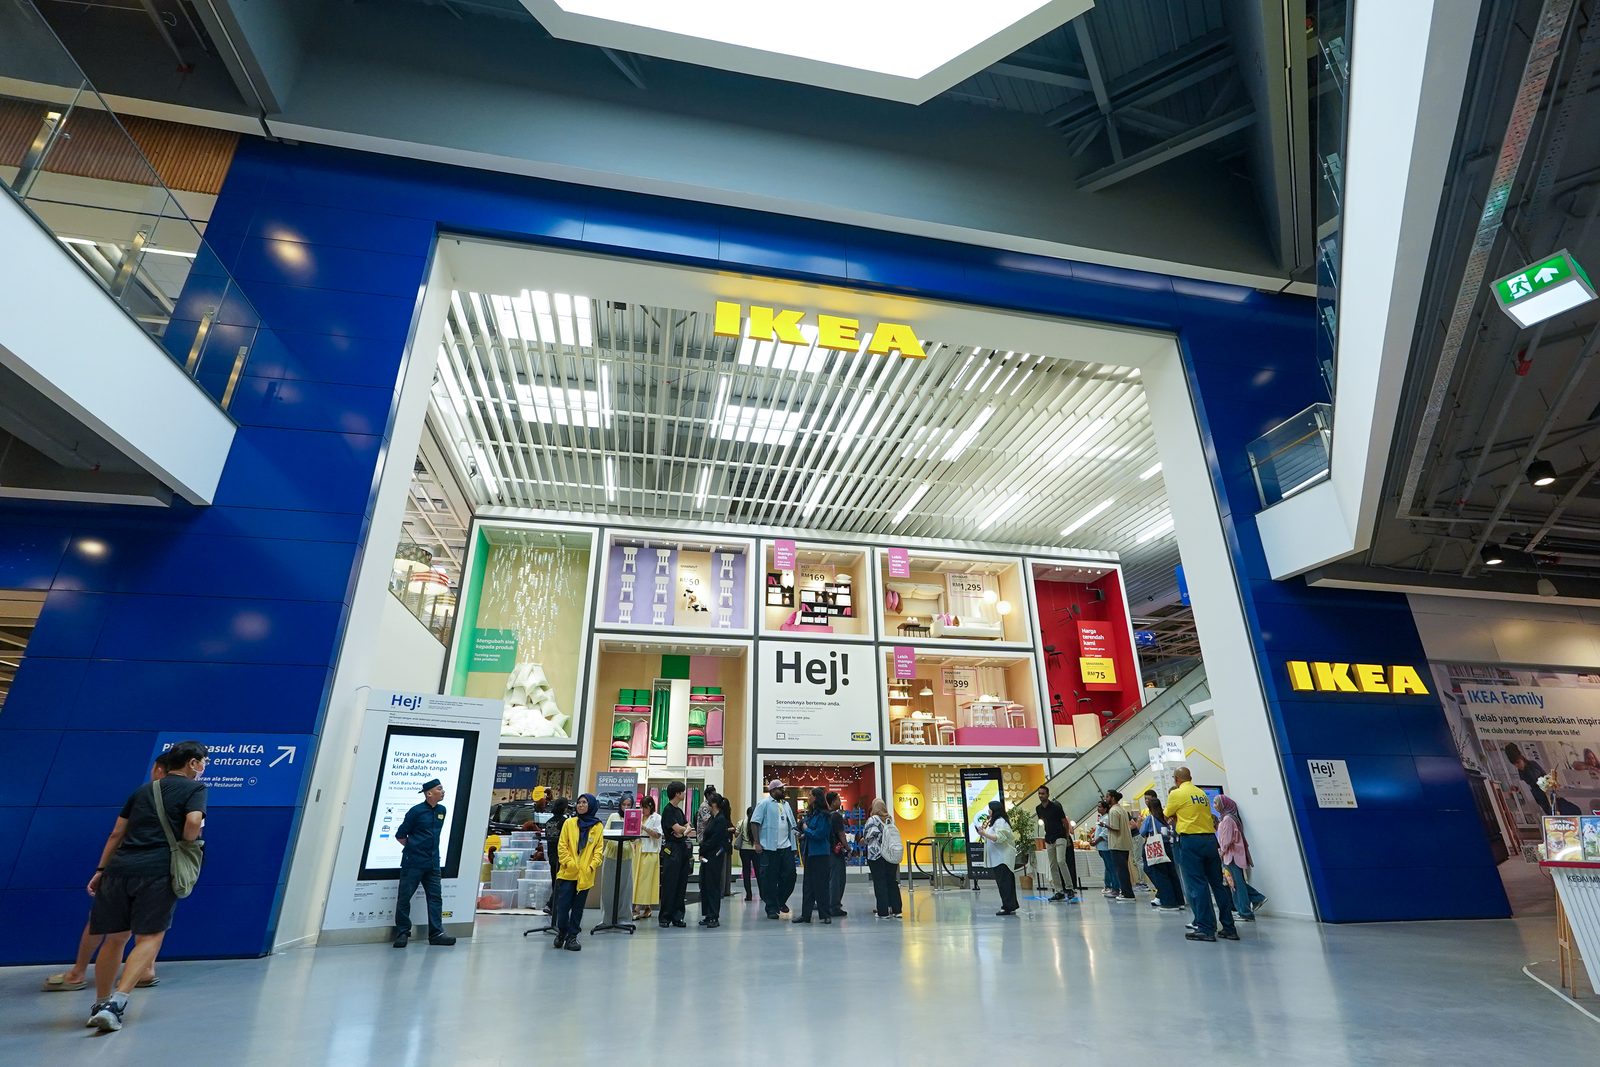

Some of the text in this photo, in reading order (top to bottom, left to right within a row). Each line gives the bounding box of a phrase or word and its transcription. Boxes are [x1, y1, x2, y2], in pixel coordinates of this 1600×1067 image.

[714, 301, 927, 359] IKEA
[801, 573, 825, 581] RM169
[952, 582, 982, 592] RM1,295
[776, 651, 849, 695] Hej!
[1286, 661, 1430, 694] IKEA
[945, 680, 969, 688] RM399
[391, 694, 422, 710] Hej!
[1467, 690, 1544, 709] IKEA Family
[1475, 714, 1498, 722] Kelab
[1499, 716, 1519, 725] yang
[1519, 716, 1575, 724] merealisasikan
[206, 744, 264, 753] asuk IKEA
[1310, 762, 1335, 777] Hej!
